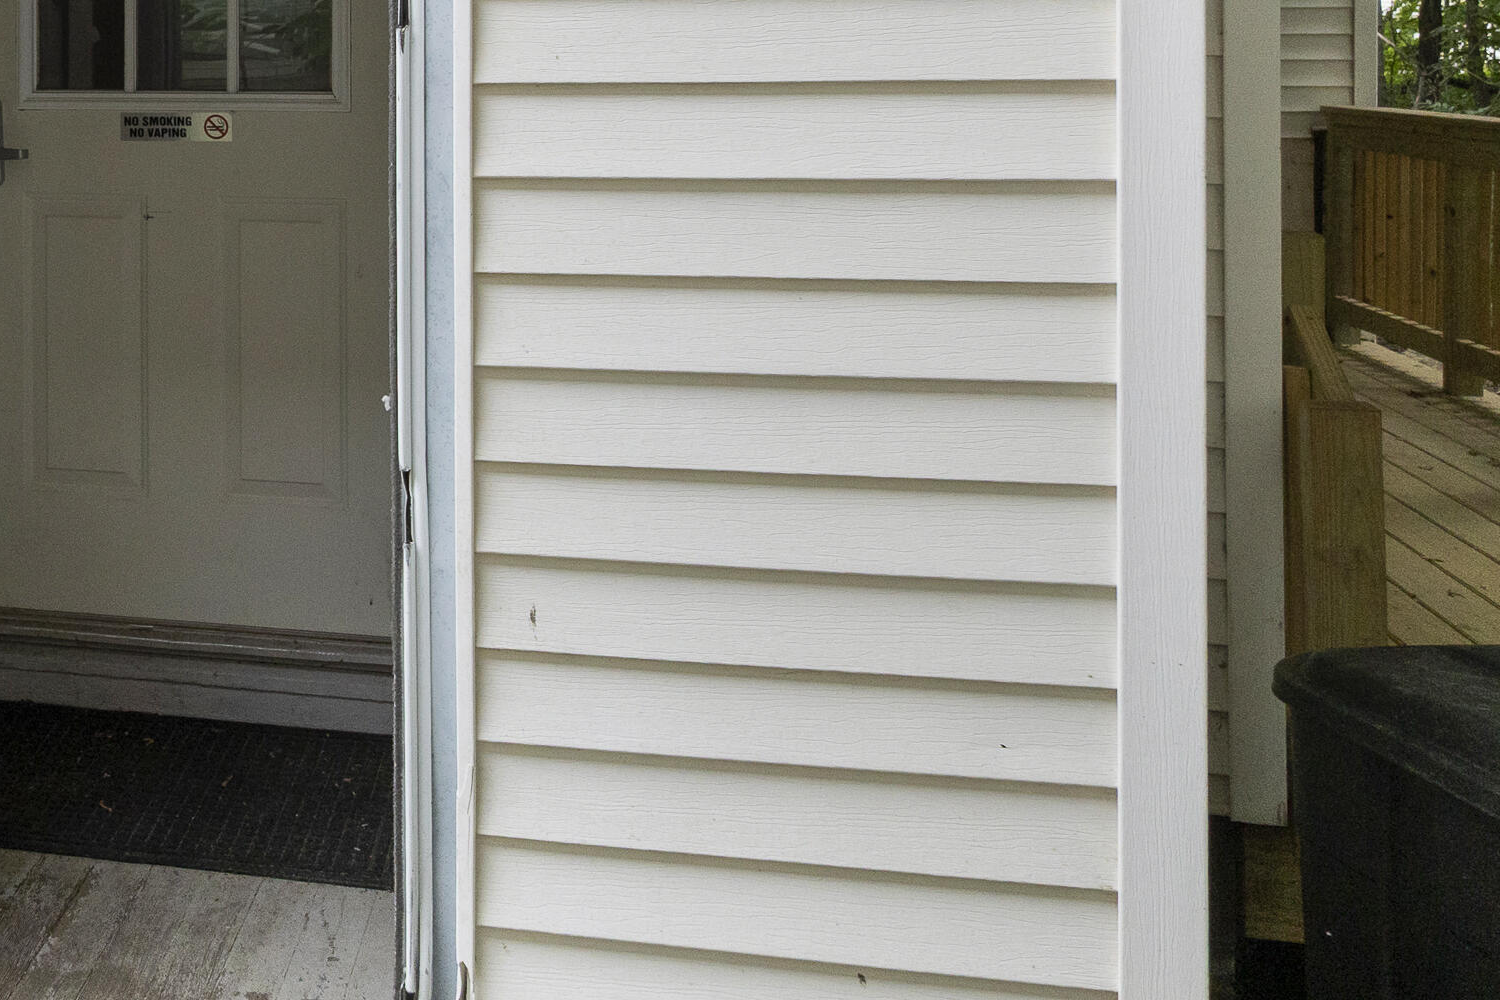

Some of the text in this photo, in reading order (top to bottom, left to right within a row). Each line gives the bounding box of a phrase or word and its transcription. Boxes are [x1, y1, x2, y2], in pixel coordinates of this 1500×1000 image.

[124, 116, 192, 127] NO SMOKING
[129, 128, 188, 138] NO VAPING
